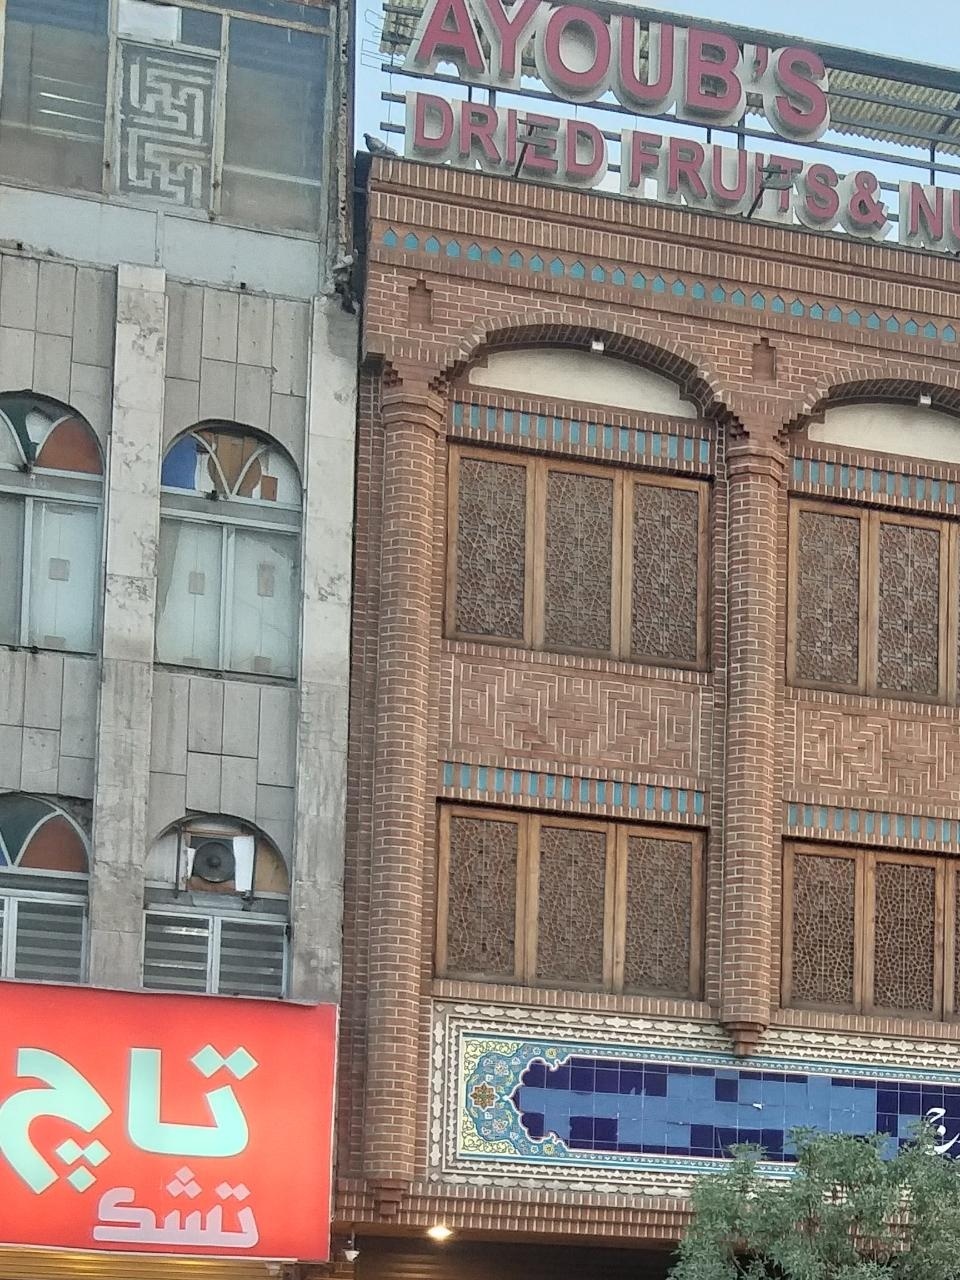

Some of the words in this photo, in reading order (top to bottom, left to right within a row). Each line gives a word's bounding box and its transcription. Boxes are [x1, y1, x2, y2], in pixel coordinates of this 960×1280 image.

[405, 0, 831, 140] AYOUB'S
[407, 90, 608, 186] DRIED
[623, 130, 843, 225] FRUITS
[845, 169, 892, 238] &
[92, 1165, 260, 1248] تشک
